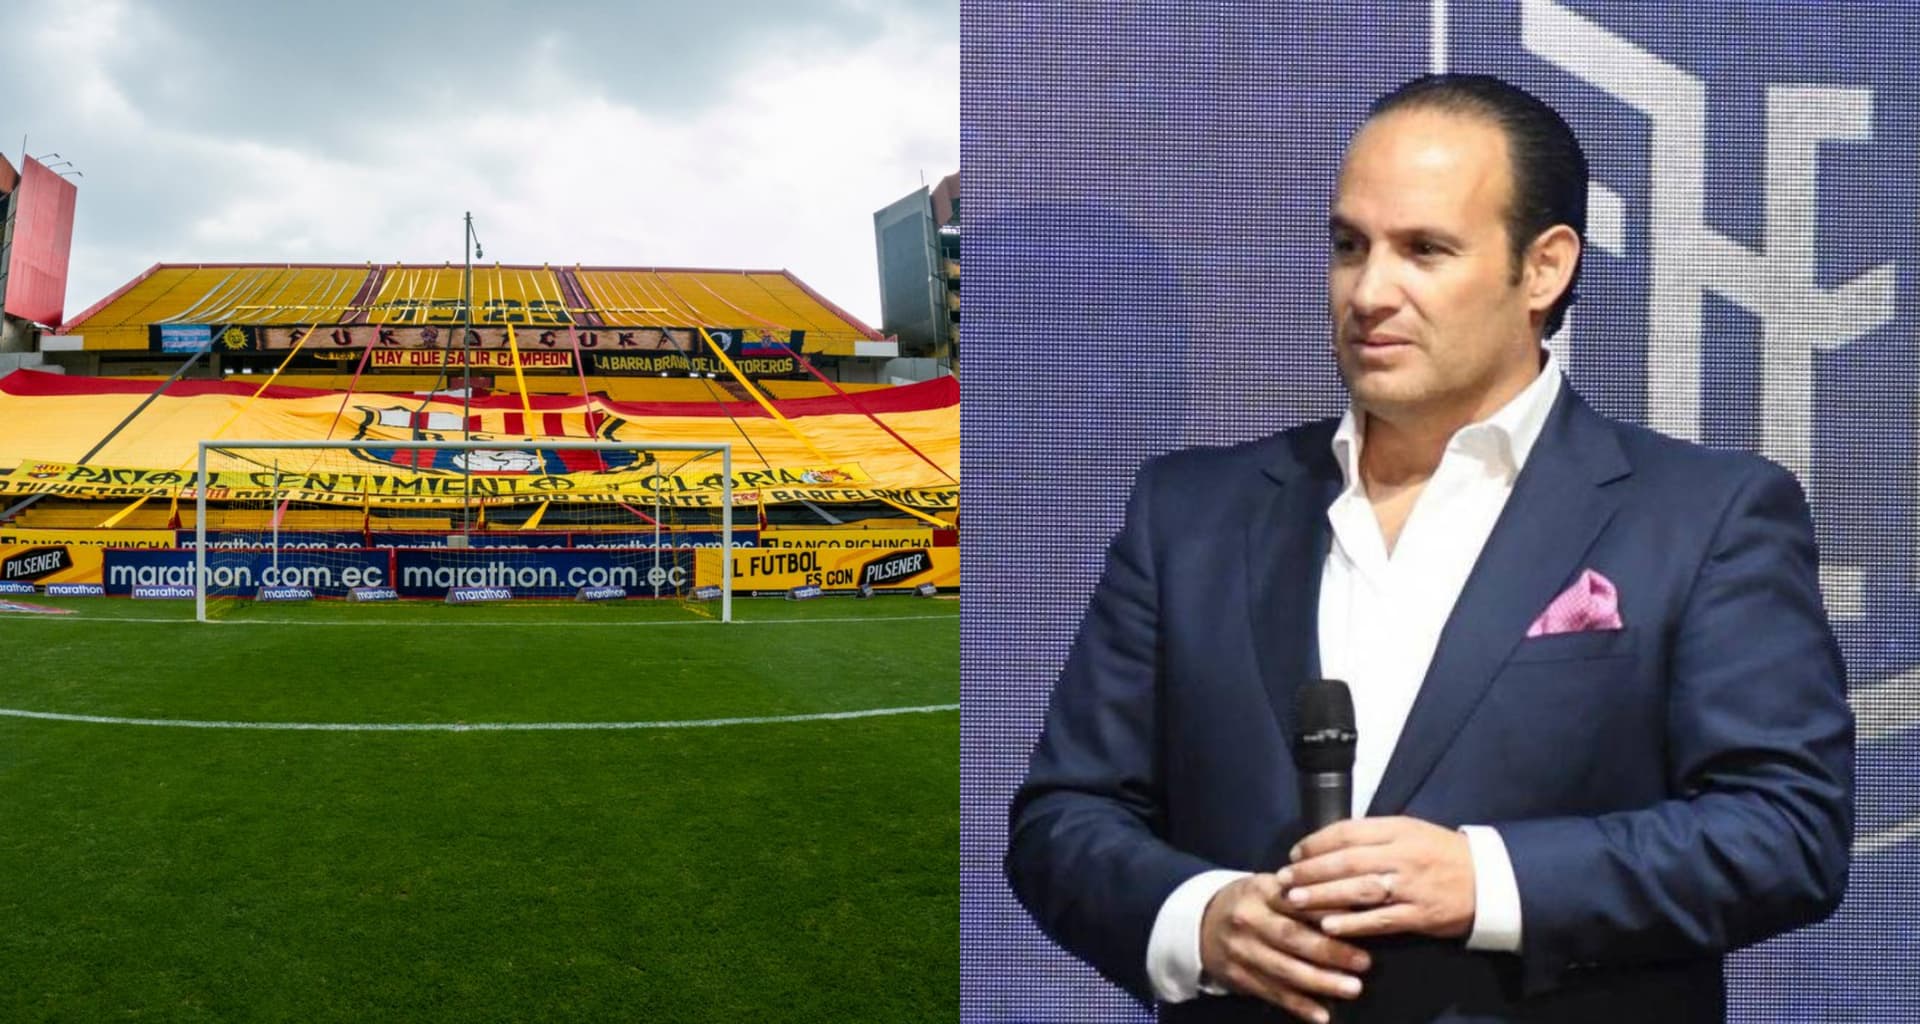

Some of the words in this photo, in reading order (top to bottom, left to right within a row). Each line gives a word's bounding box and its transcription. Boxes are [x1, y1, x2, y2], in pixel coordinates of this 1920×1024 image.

[375, 351, 404, 364] HAY
[410, 351, 440, 365] QUE
[447, 351, 490, 365] SALIR
[497, 352, 568, 366] CAMPEON
[593, 354, 609, 369] LA
[610, 355, 653, 370] BARRA
[653, 354, 690, 372] BRAVA
[692, 355, 708, 371] DE
[710, 357, 733, 373] LO
[736, 358, 793, 373] TOREROS
[6, 550, 61, 579] PILSENER
[750, 549, 822, 577] FÚTBOL
[866, 552, 923, 584] PILSENER
[111, 560, 383, 587] marathon.com.ec
[403, 561, 688, 587] marathon.com.ec
[805, 573, 822, 586] ES
[826, 568, 853, 586] CON
[49, 584, 104, 596] marathon
[135, 586, 195, 599] marathon
[264, 587, 313, 600] marathon
[356, 587, 398, 601] marathon
[455, 587, 512, 601] marathon
